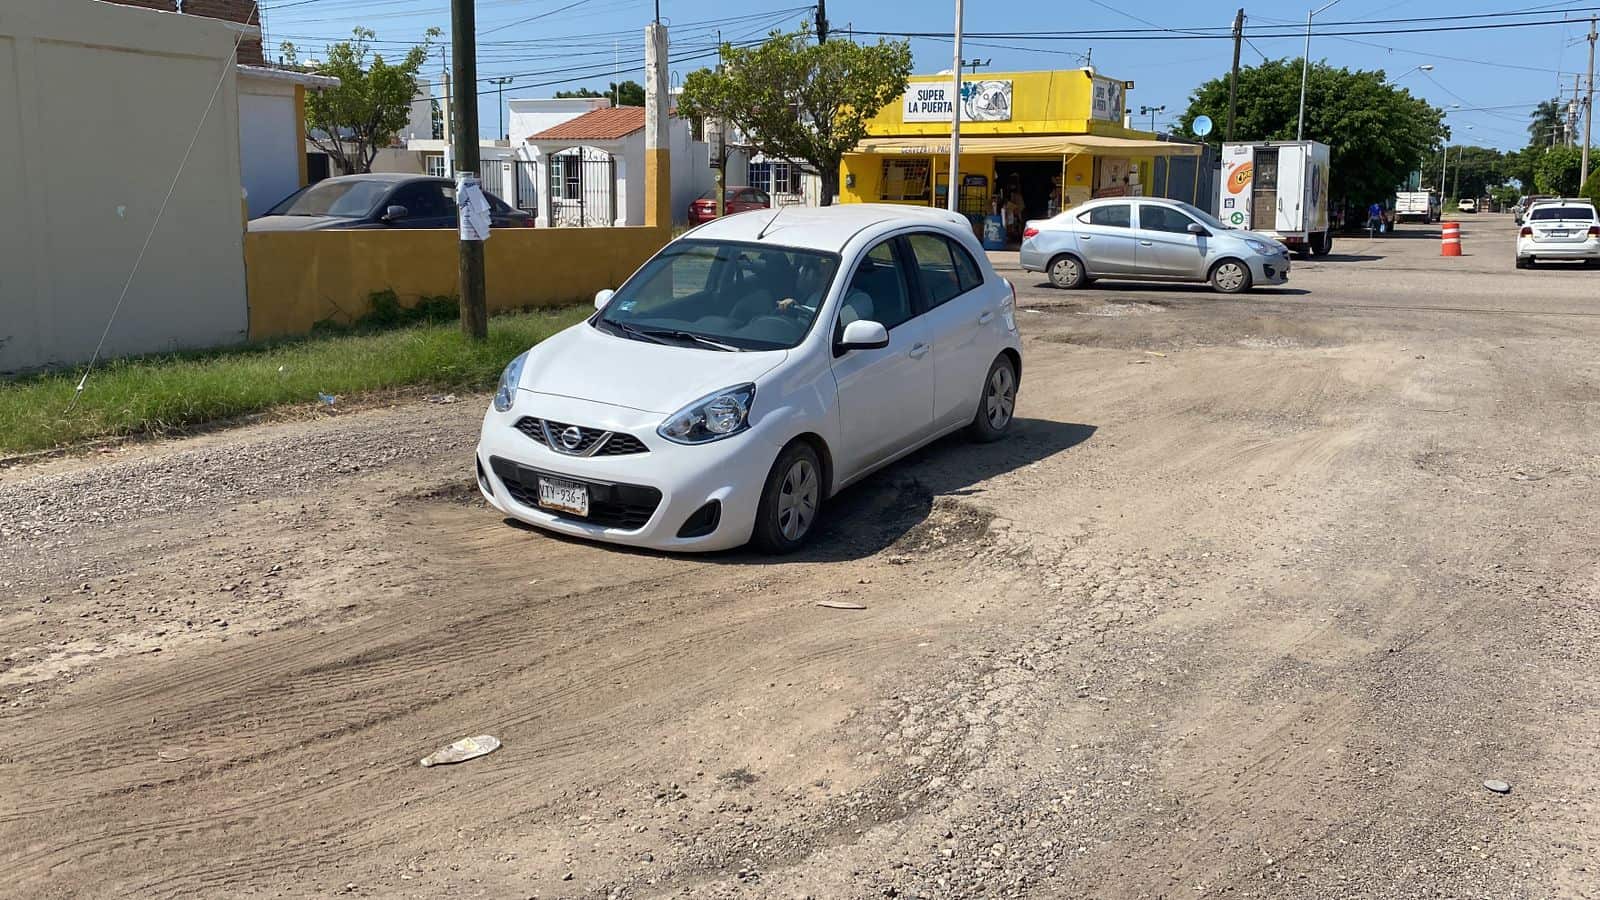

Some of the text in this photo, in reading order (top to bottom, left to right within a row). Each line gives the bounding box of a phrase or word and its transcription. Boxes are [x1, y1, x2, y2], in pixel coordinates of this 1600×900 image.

[917, 90, 944, 101] SUPER
[908, 102, 953, 112] LA PUERTA
